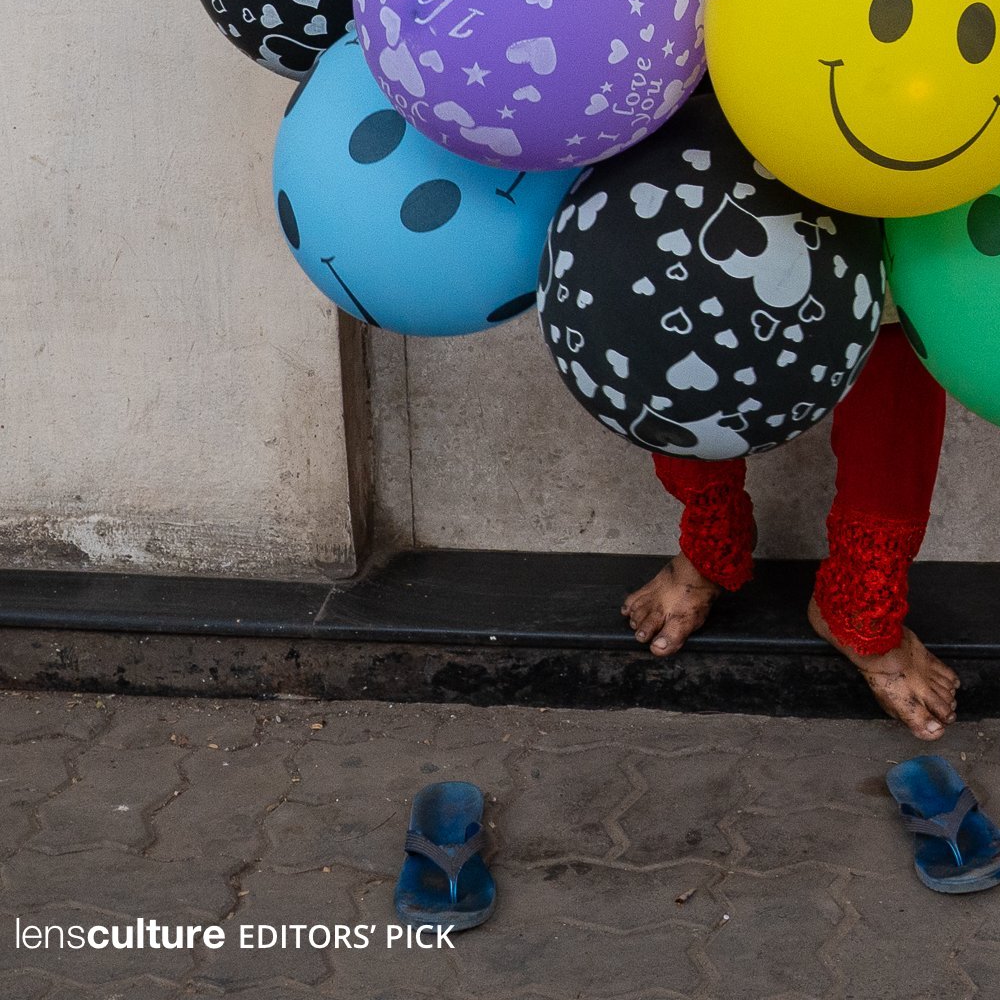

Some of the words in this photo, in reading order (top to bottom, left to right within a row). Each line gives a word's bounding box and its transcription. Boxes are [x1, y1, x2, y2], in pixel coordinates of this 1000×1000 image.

[448, 8, 485, 38] I
[378, 75, 430, 123] you
[597, 131, 620, 142] I
[613, 57, 652, 115] love
[631, 78, 663, 127] you
